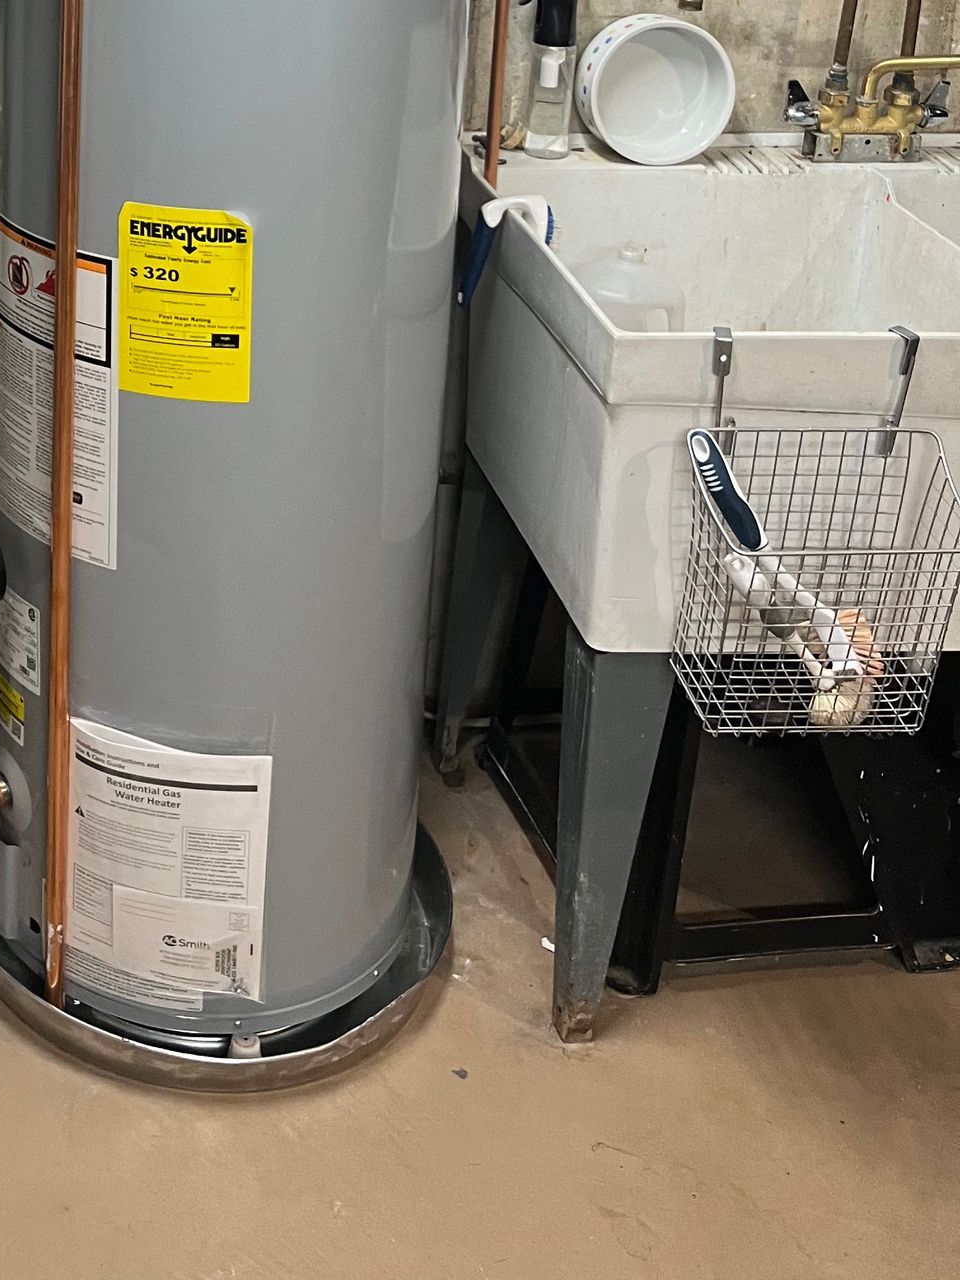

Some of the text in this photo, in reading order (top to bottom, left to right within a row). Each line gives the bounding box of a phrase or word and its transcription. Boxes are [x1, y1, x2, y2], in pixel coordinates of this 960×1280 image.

[130, 219, 247, 245] ENERGYGUIDE
[143, 266, 179, 282] 320
[190, 316, 211, 324] Rating
[106, 753, 145, 767] Instructions
[106, 760, 125, 770] Guide
[106, 776, 181, 798] Residential Gas
[114, 789, 144, 803] Water
[147, 797, 181, 809] Heater
[178, 938, 211, 950] Smith
